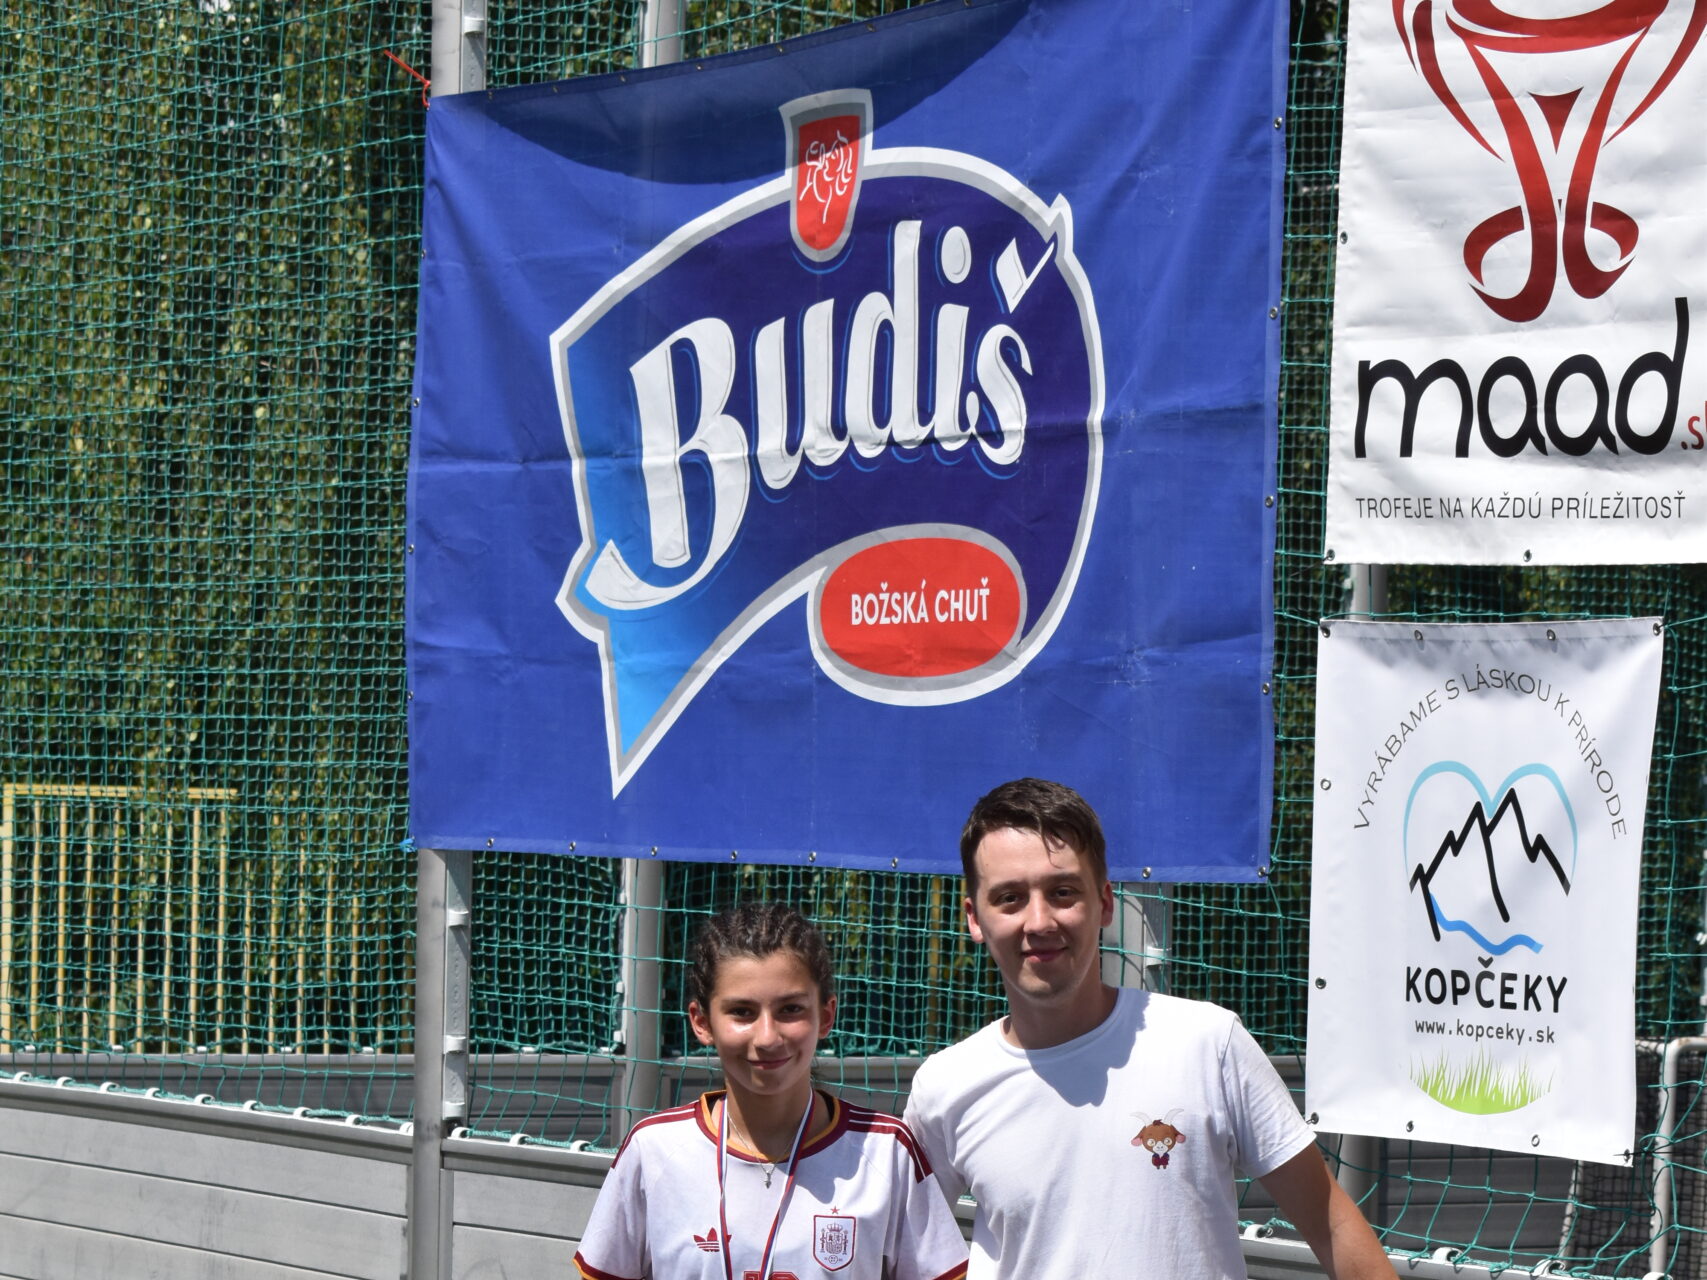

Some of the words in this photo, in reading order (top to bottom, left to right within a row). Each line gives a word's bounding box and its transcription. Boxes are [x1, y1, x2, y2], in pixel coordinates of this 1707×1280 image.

[1353, 296, 1707, 458] maad.s
[586, 219, 1055, 611] Budiš
[1355, 497, 1434, 519] TROFEJE
[1439, 497, 1465, 519] NA
[1471, 491, 1542, 519] KAŽDÚ
[1551, 490, 1686, 519] PRÍLEŽITOSŤ
[850, 578, 930, 626] BOŽSKÁ
[934, 576, 990, 623] CHUŤ
[1353, 688, 1442, 830] VYRÁBAME
[1444, 678, 1460, 700] S
[1461, 663, 1552, 702] LÁSKOU
[1553, 692, 1570, 718] K
[1567, 709, 1628, 840] PRÍRODE
[1405, 955, 1568, 1014] KOPČEKY
[1414, 1018, 1556, 1046] www.kopceky.sk
